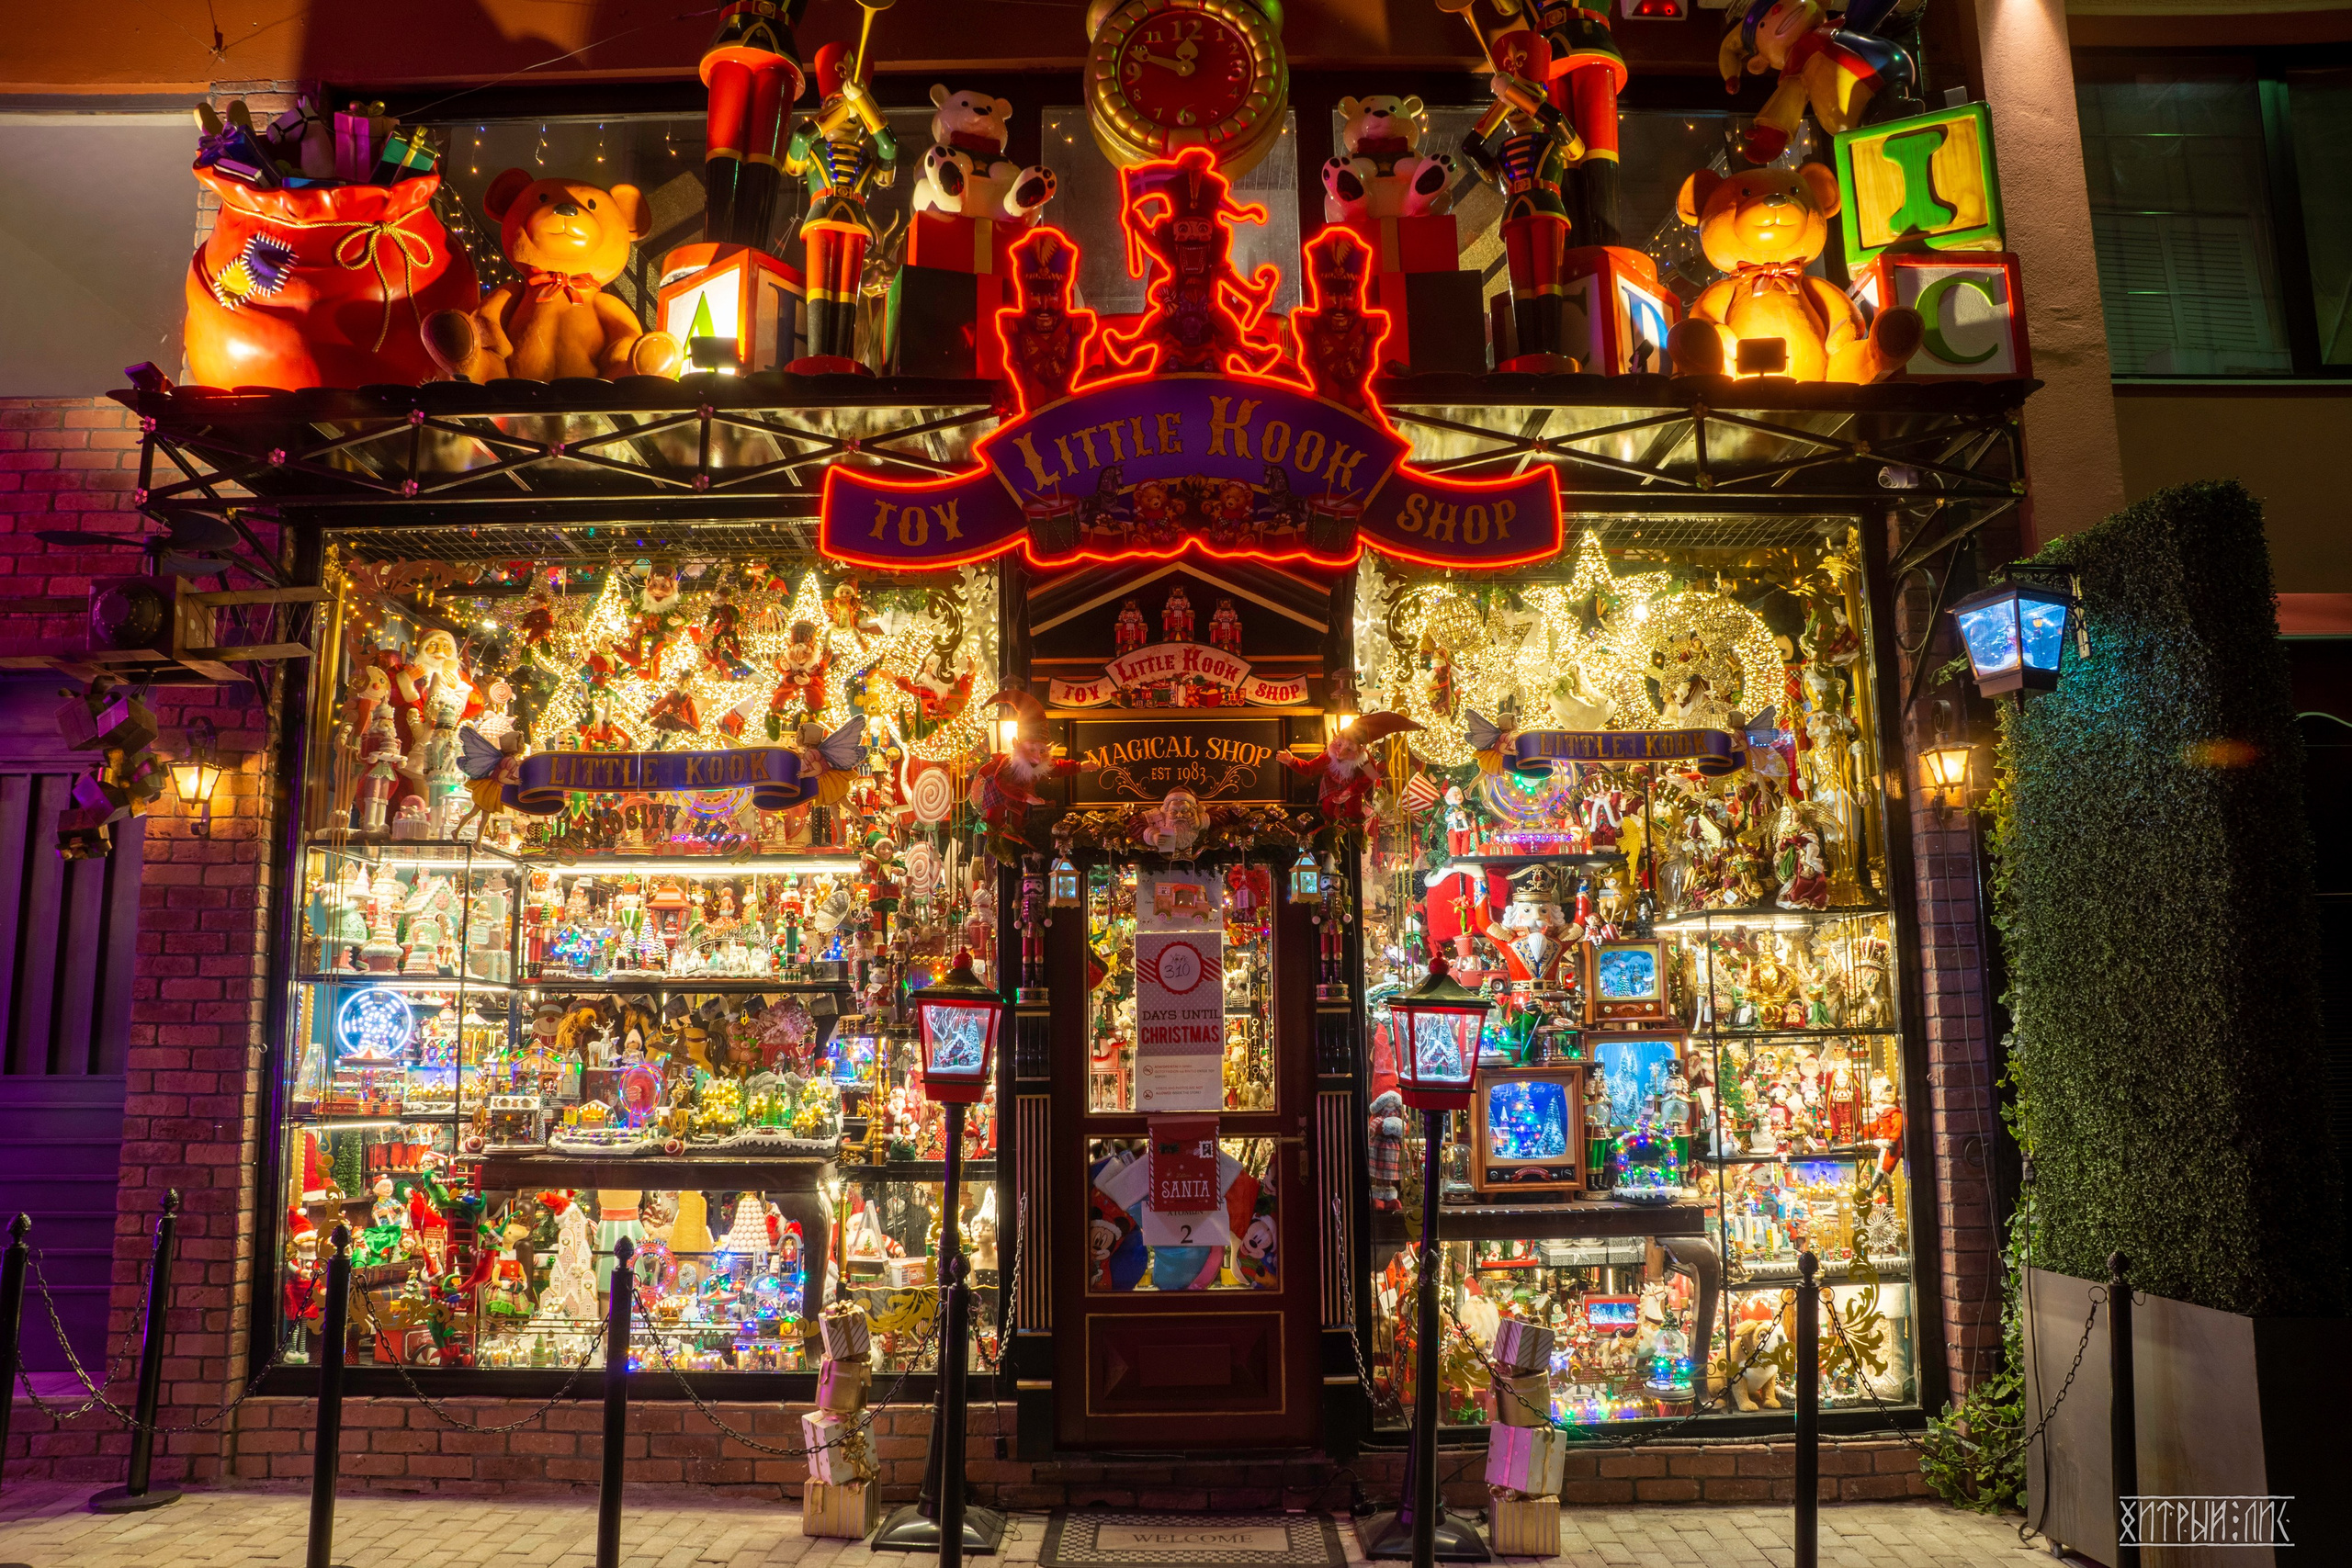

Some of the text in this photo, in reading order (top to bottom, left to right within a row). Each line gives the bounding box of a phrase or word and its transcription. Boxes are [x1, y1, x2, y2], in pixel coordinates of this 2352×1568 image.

[1145, 31, 1162, 43] 11
[1170, 19, 1204, 41] 12
[1215, 28, 1225, 41] 1
[1229, 42, 1239, 55] 2
[1125, 62, 1143, 85] 9
[1227, 60, 1247, 82] 3
[1176, 104, 1197, 126] 6
[1013, 396, 1369, 491] LITTLE KOOK
[868, 497, 963, 547] TOY
[1397, 492, 1518, 545] SHOP
[1114, 649, 1241, 683] LITTLE KOOK
[1063, 683, 1100, 703] TOY
[1255, 682, 1300, 702] SHOP
[1084, 737, 1272, 769] MAGICAL SHOP
[1540, 732, 1710, 758] LITTLE KOOK
[549, 751, 770, 786] LITTLE KOOK
[1151, 761, 1207, 785] EST 1983
[1549, 771, 1702, 818] CURIOSITY SHOP
[554, 804, 753, 865] CURIOSITY SHOP
[1164, 963, 1191, 979] 310
[1142, 1009, 1221, 1021] DAYS UNTIL
[1141, 1025, 1220, 1044] CHRISTMAS
[1161, 1180, 1210, 1198] SANTA
[1181, 1224, 1193, 1244] 2
[1133, 1533, 1253, 1544] WELCOME
